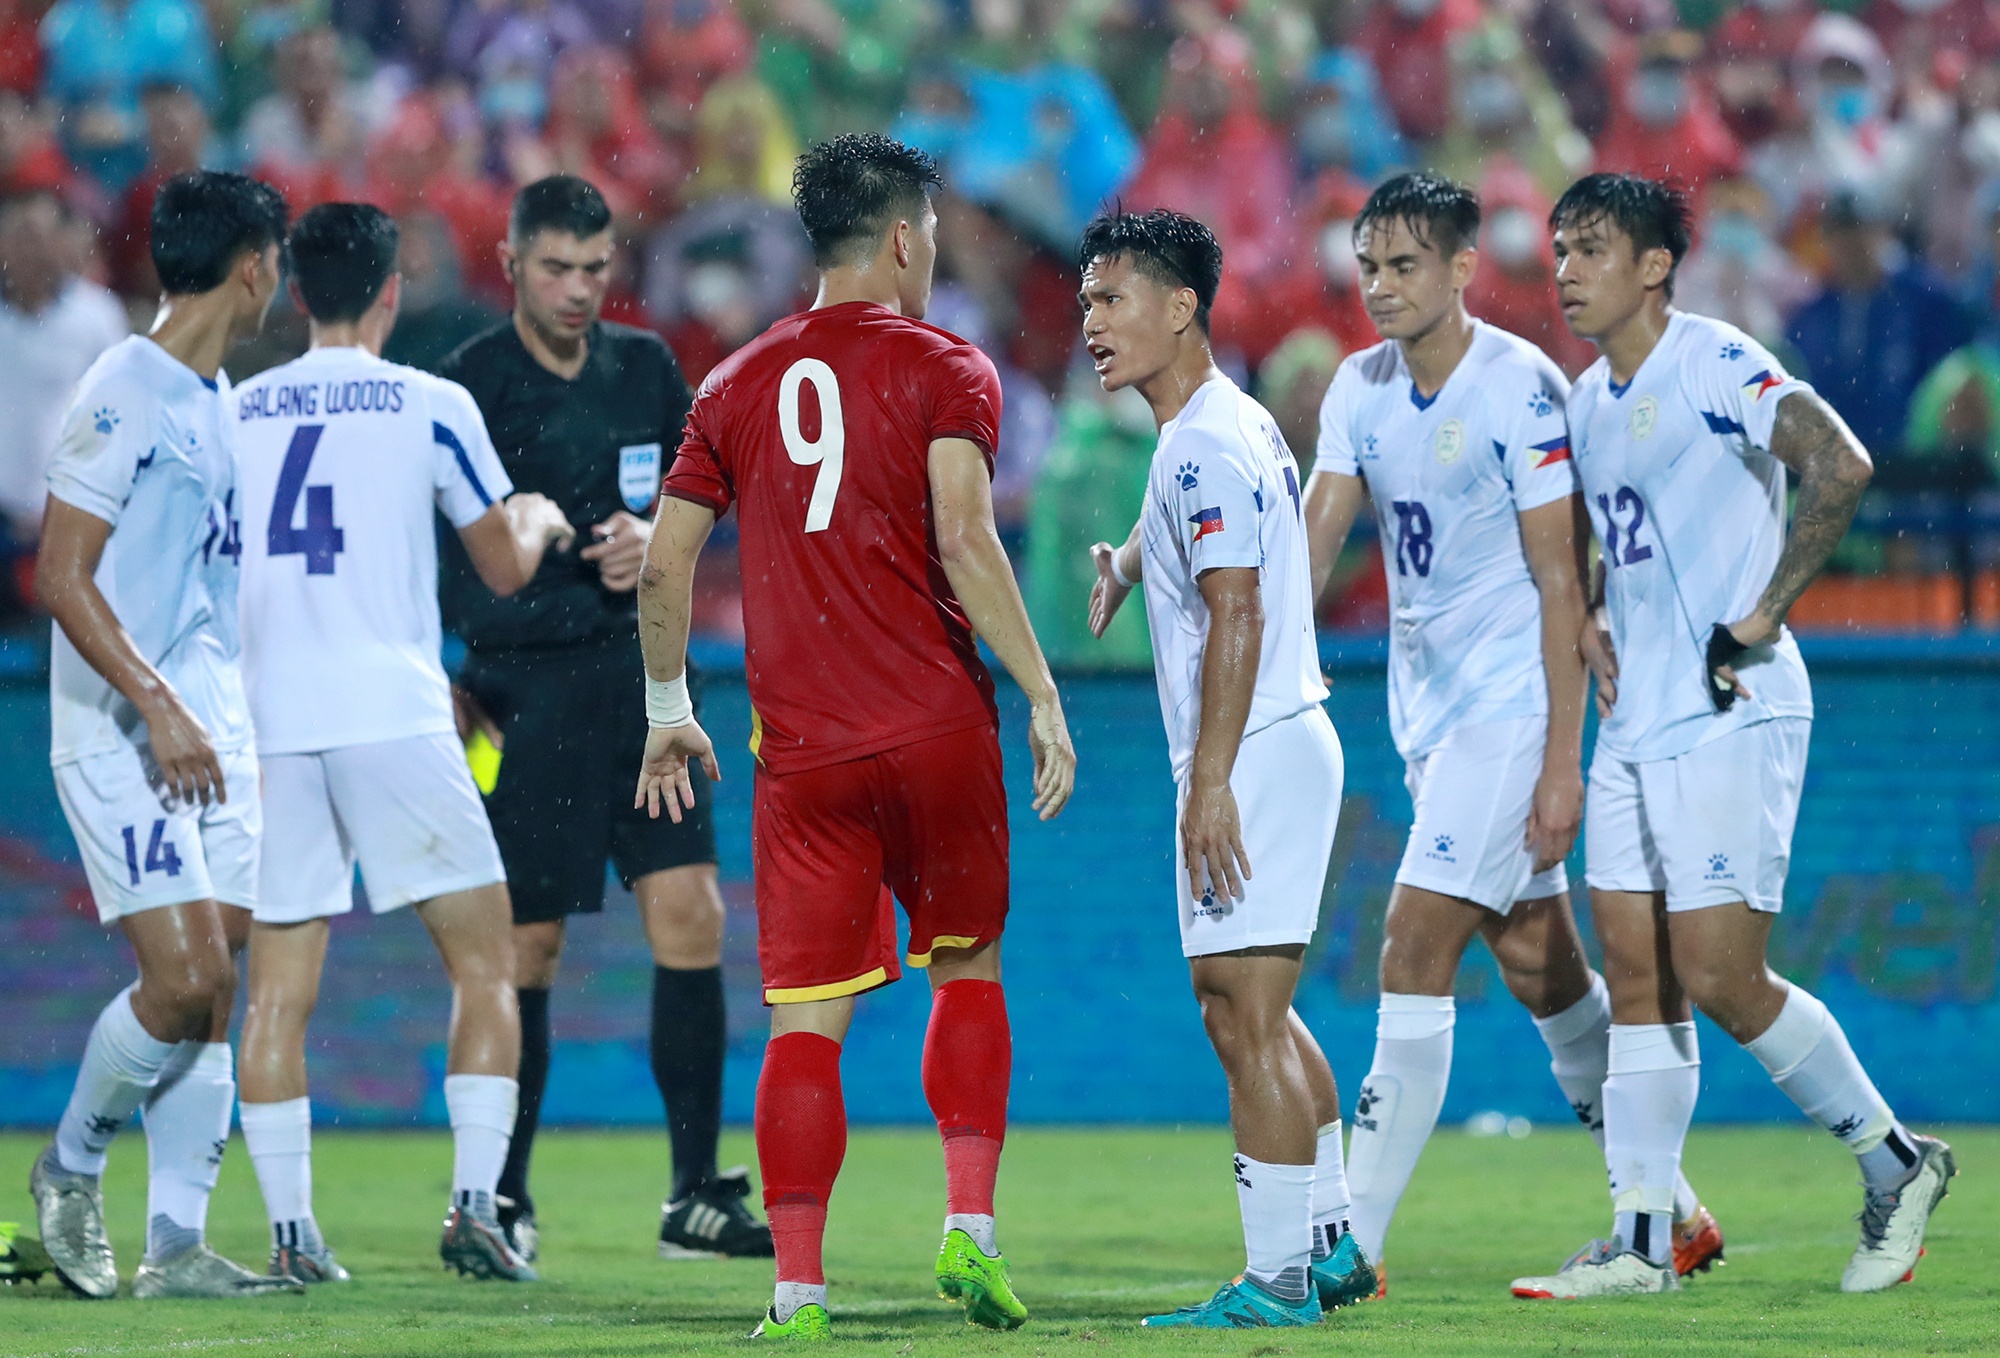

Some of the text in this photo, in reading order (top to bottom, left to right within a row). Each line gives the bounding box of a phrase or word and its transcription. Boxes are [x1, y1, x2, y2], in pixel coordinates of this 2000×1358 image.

[239, 380, 405, 420] GALANG WOODS
[778, 357, 845, 533] 9
[267, 425, 344, 574] 4
[1283, 466, 1300, 527] 1
[1597, 485, 1653, 568] 12
[1392, 501, 1433, 577] 18
[122, 818, 183, 886] 14
[1193, 906, 1225, 918] KELME
